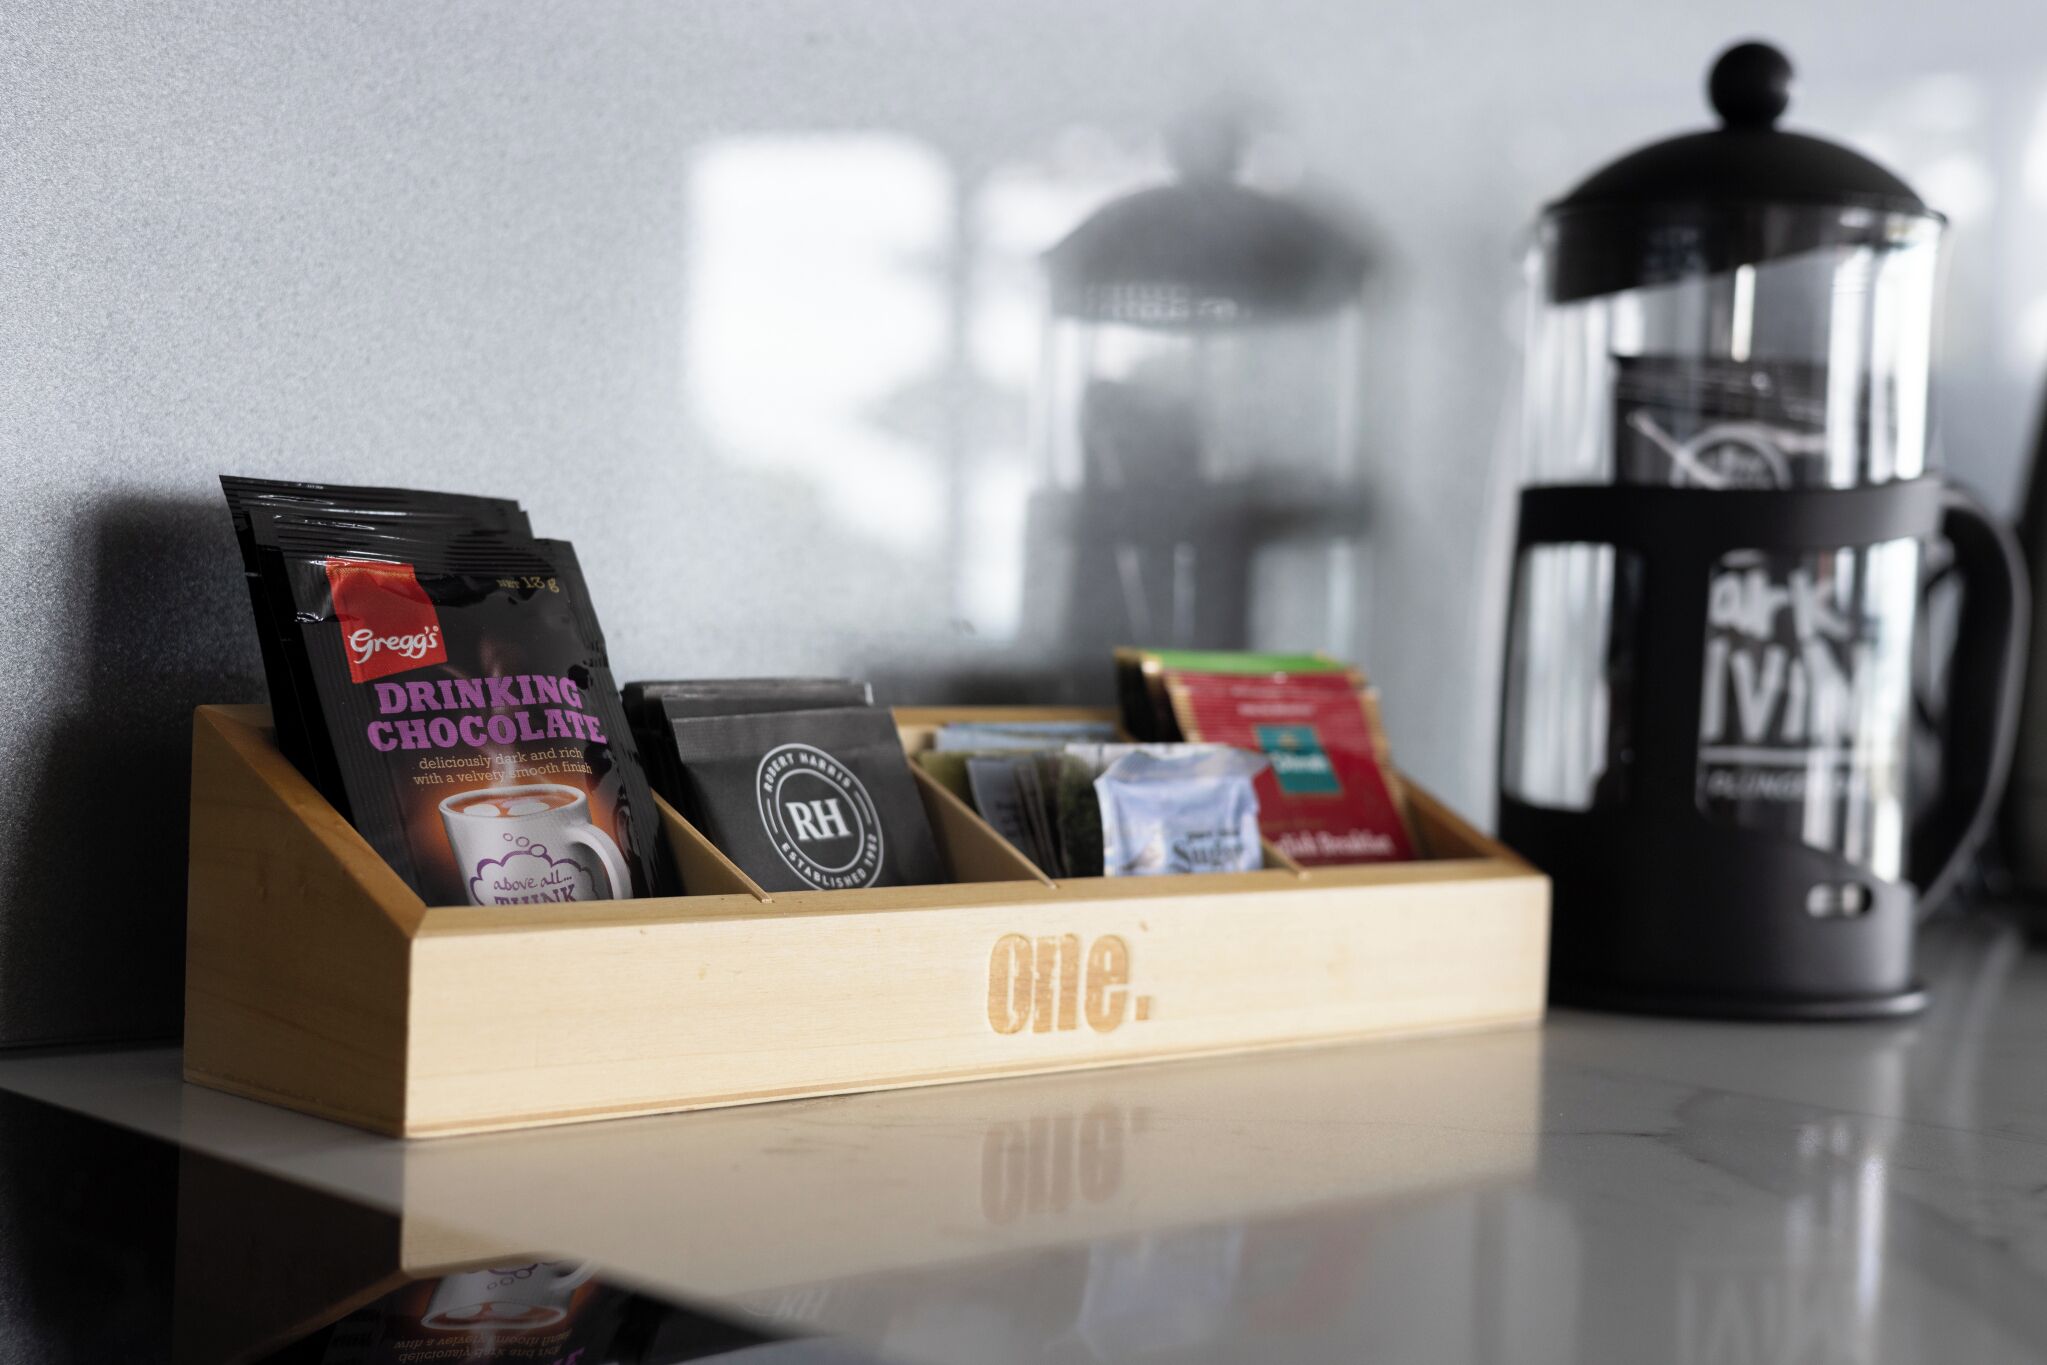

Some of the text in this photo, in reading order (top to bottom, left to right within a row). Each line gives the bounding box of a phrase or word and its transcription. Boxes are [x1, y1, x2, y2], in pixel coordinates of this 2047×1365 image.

[348, 626, 438, 664] Gregg's
[374, 675, 583, 714] DRINKING
[367, 709, 608, 752] CHOCOLATE
[413, 760, 593, 785] with a velvety smooth finish
[419, 746, 584, 770] deliciously dark and rich
[763, 751, 852, 793] ROBERT HARRIS
[785, 798, 853, 841] RH
[493, 876, 538, 891] above
[782, 841, 867, 888] ESTABLISHED
